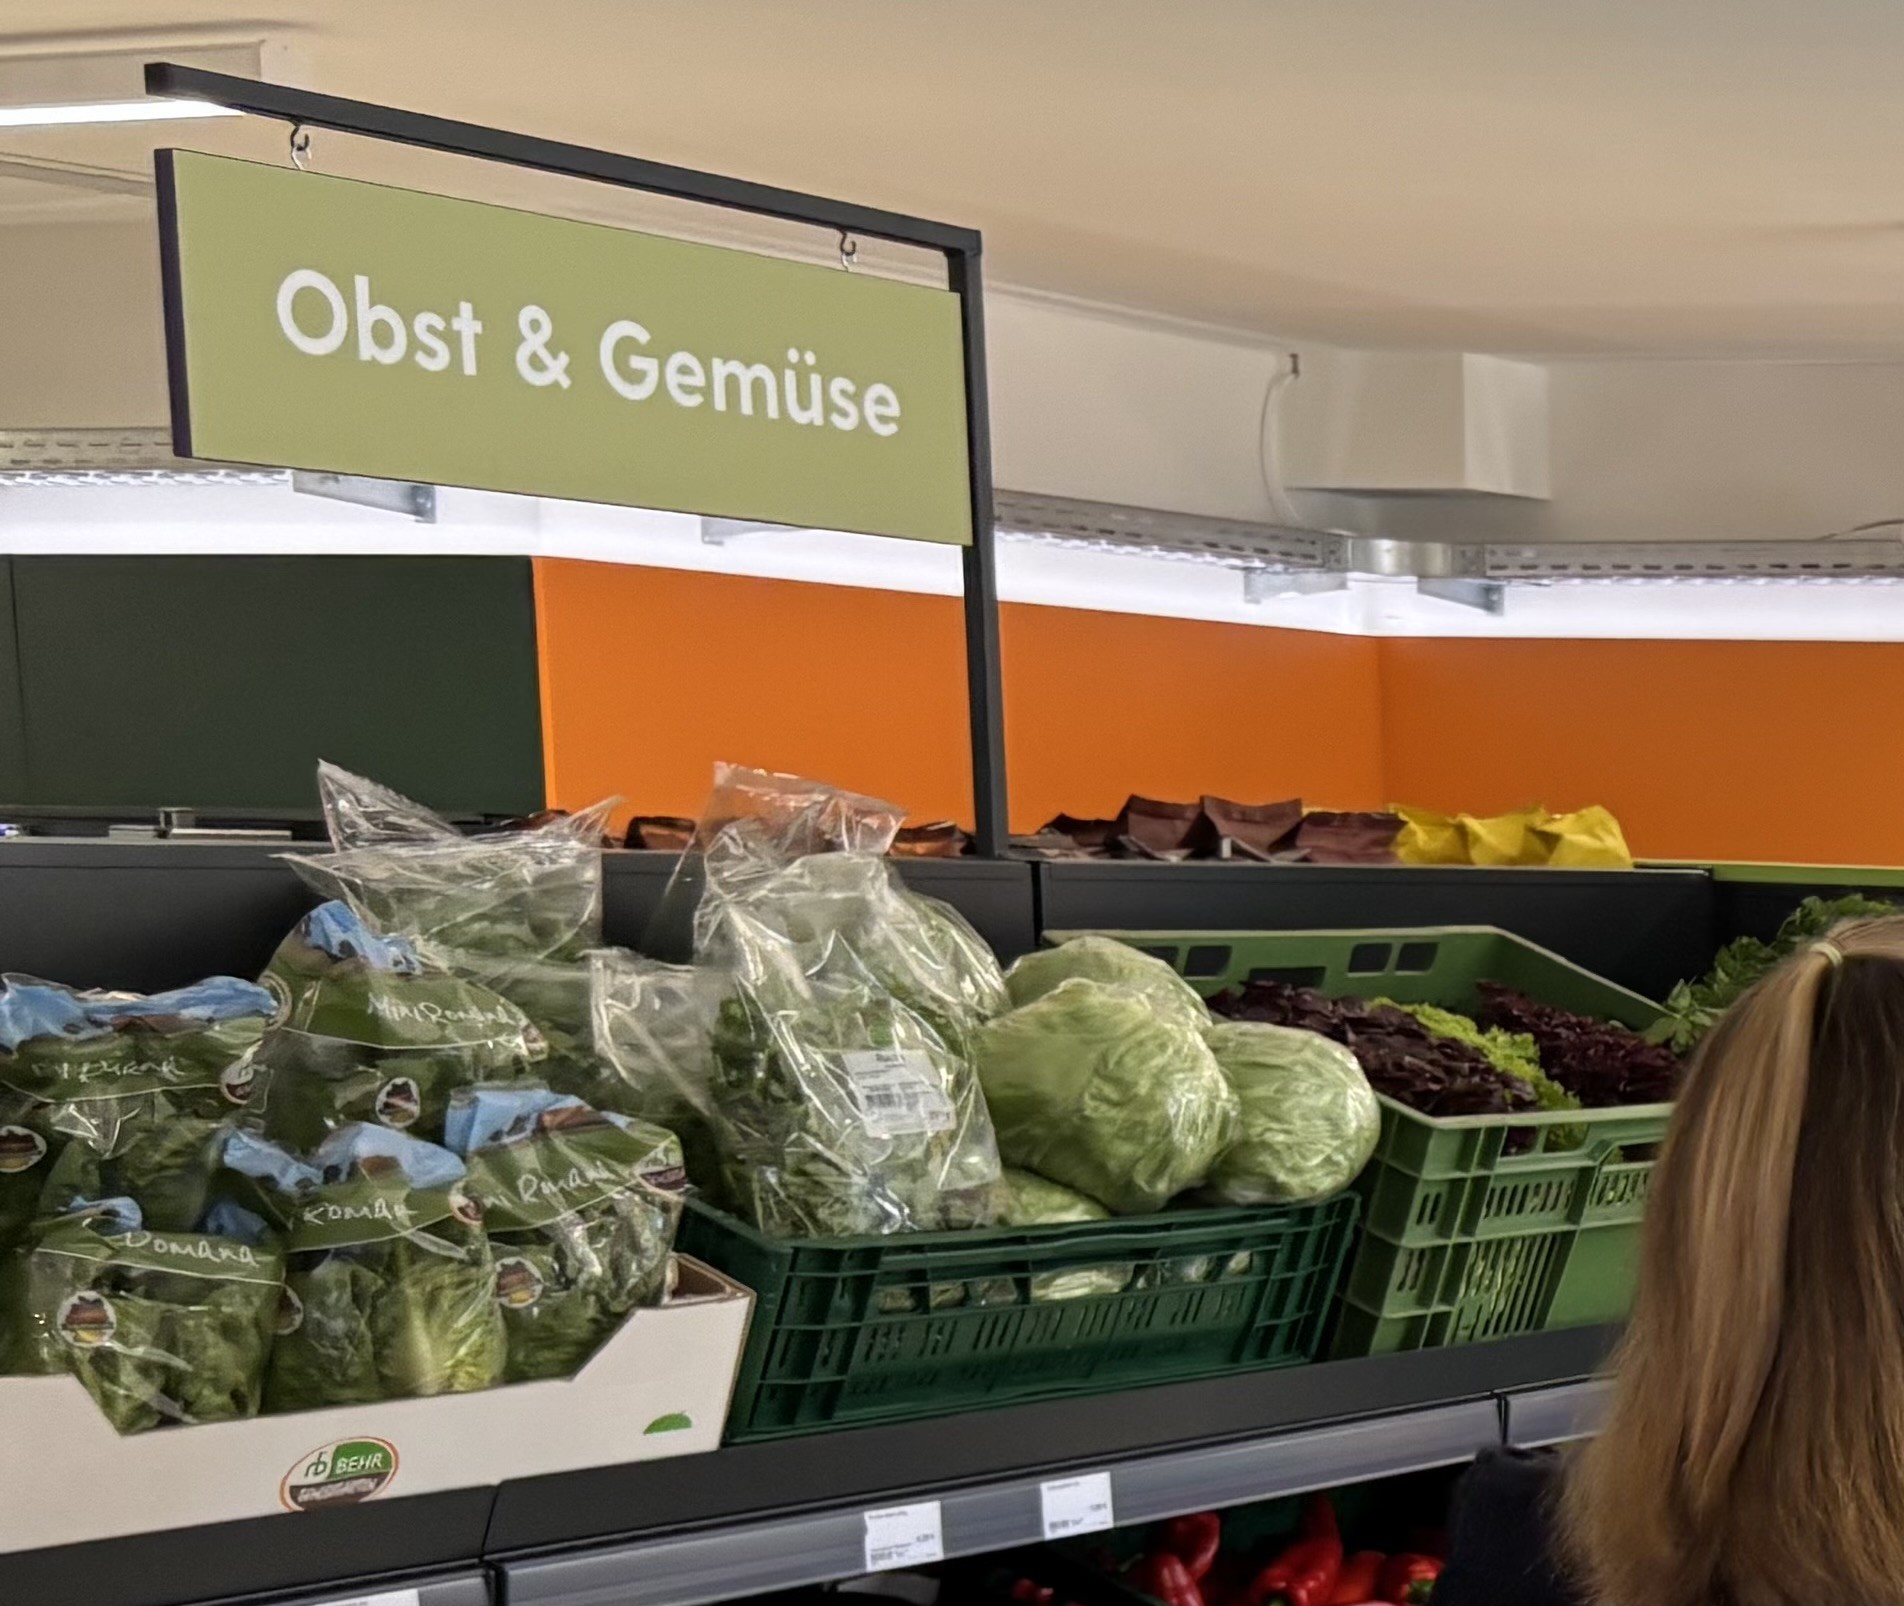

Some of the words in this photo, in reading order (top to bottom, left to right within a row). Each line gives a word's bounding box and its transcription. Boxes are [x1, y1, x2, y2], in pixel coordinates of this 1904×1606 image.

[276, 268, 483, 377] Obst
[515, 304, 572, 390] &
[599, 320, 902, 437] Gemüse
[335, 1452, 384, 1474] BEHR
